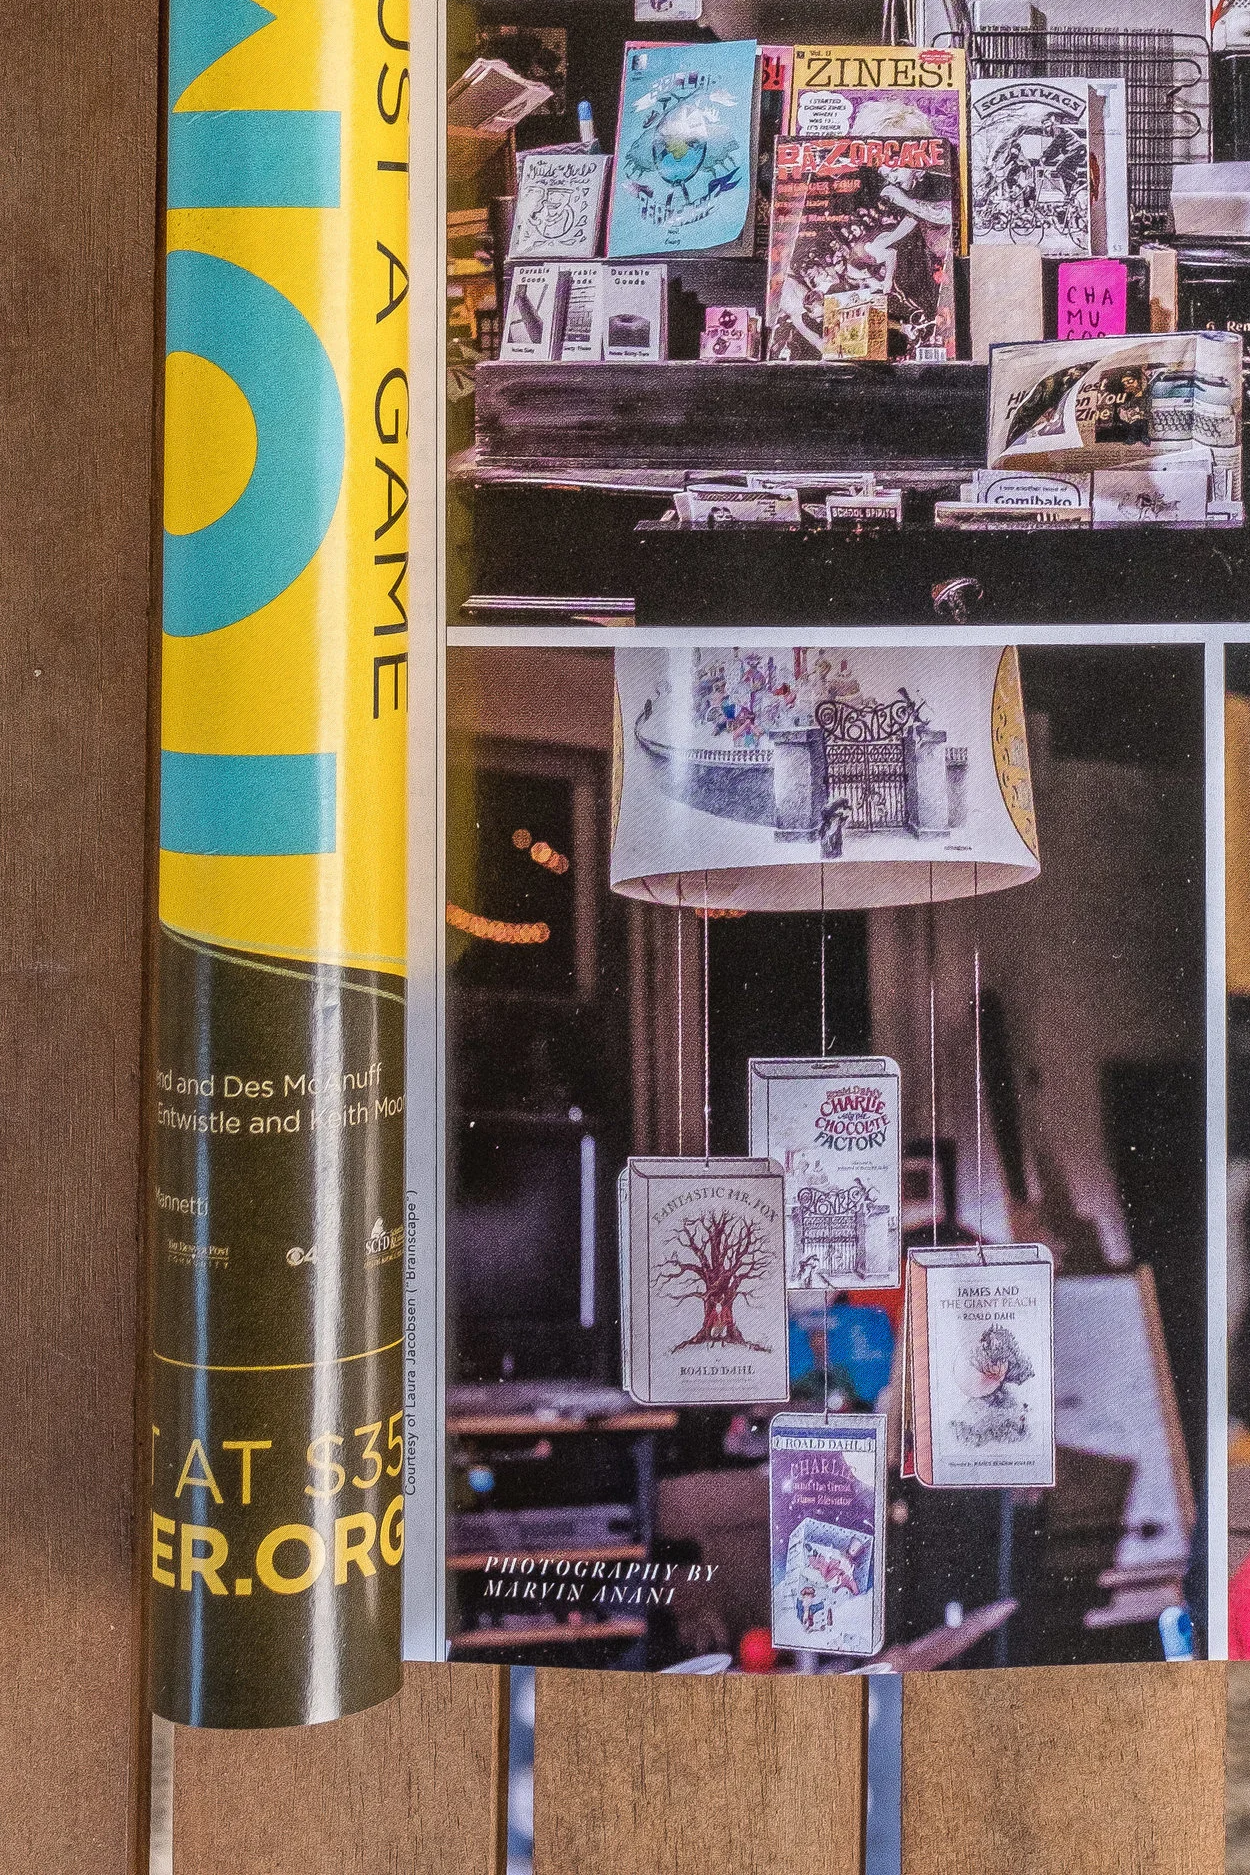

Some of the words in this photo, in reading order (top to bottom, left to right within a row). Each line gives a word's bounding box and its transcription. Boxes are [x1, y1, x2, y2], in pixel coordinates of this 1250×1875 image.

[805, 57, 954, 88] ZINES!
[980, 88, 1081, 112] SCALLYWAGS
[376, 239, 410, 325] A
[1067, 286, 1114, 306] CHA
[1067, 309, 1101, 328] MU
[374, 366, 410, 720] GAME
[176, 1075, 215, 1097] and
[224, 1074, 275, 1099] Des
[157, 1101, 241, 1134] Entwistle
[249, 1108, 300, 1134] and
[309, 1102, 368, 1131] Keith
[375, 1093, 405, 1121] Moo
[814, 1127, 888, 1152] FACTORY
[652, 1186, 726, 1225] FANTASTIC
[752, 1198, 779, 1223] FOX
[957, 1287, 991, 1298] JAMES
[994, 1286, 1020, 1297] AND
[963, 1298, 999, 1309] GIANT
[1001, 1297, 1037, 1308] PEACH
[403, 1297, 418, 1366] Jacobsen
[403, 1369, 418, 1409] Laura
[174, 1437, 273, 1505] AT
[303, 1409, 404, 1504] $35
[785, 1438, 825, 1450] ROALD
[828, 1439, 863, 1451] DAHL
[403, 1431, 420, 1497] Courtesy
[152, 1493, 405, 1595] ER.ORG
[484, 1555, 678, 1582] PHOTOGRAPHY
[686, 1563, 719, 1583] BY
[483, 1579, 584, 1602] MARVIN
[592, 1584, 676, 1606] ANANI
